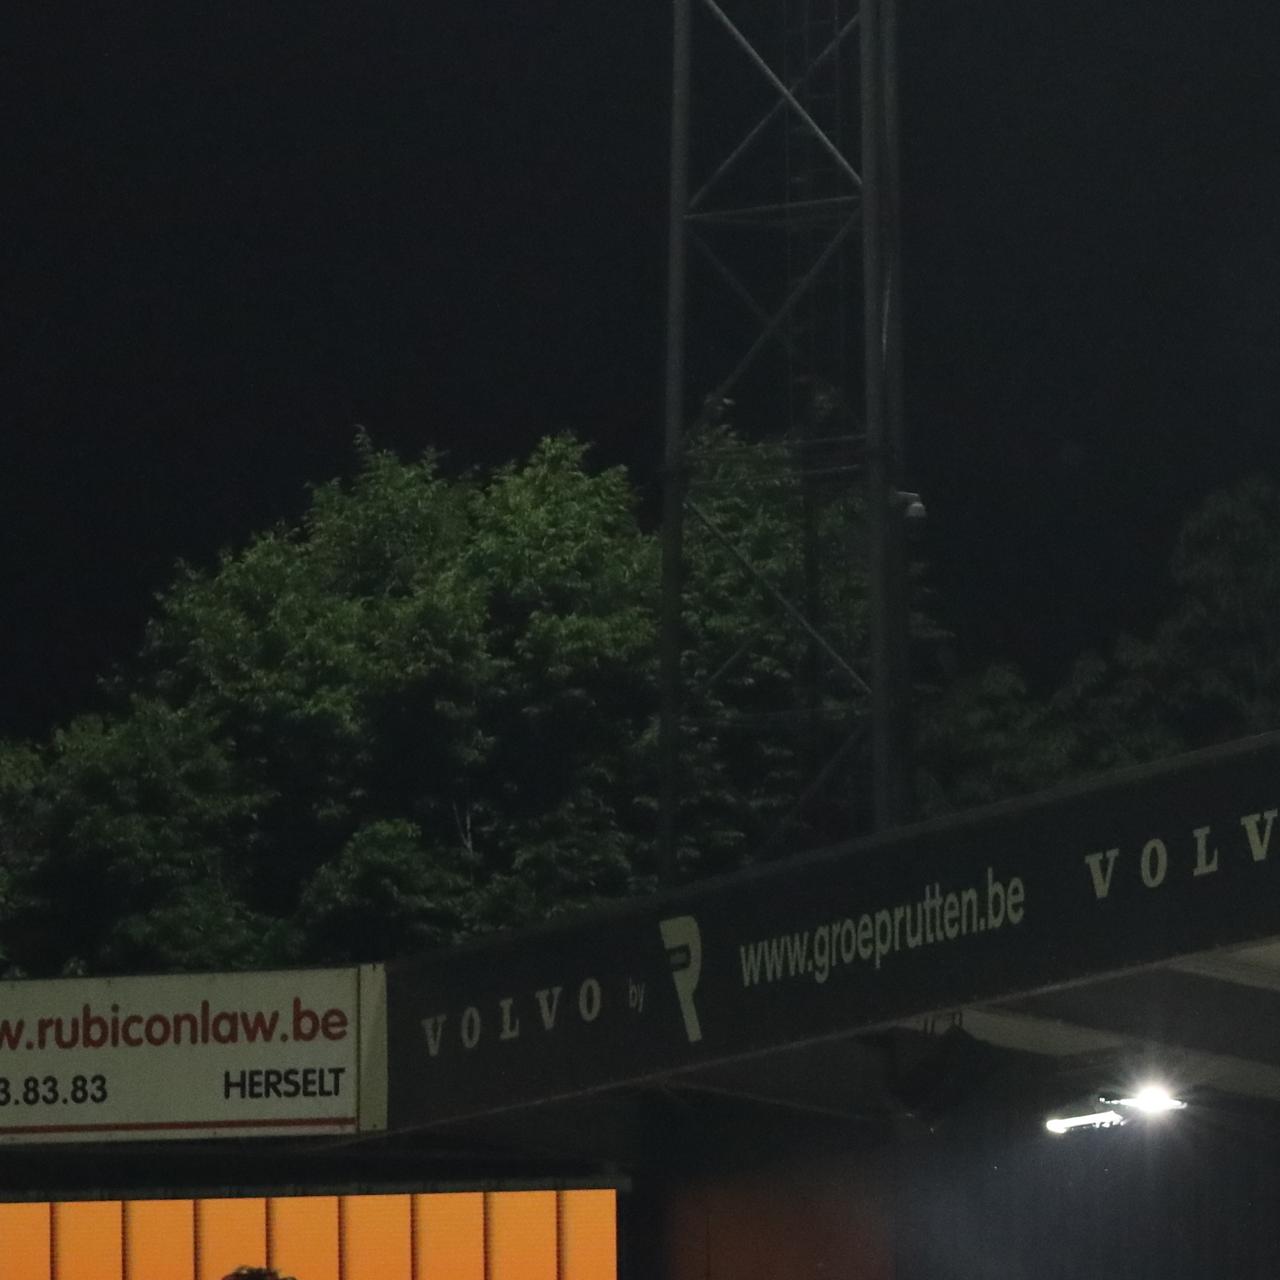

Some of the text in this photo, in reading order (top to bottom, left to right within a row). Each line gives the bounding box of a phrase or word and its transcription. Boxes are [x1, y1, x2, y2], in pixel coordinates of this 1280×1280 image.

[740, 867, 1026, 987] www.groeprutten.be
[421, 976, 602, 1057] VOLVO
[628, 977, 647, 1013] by
[223, 1067, 346, 1100] HERSELT
